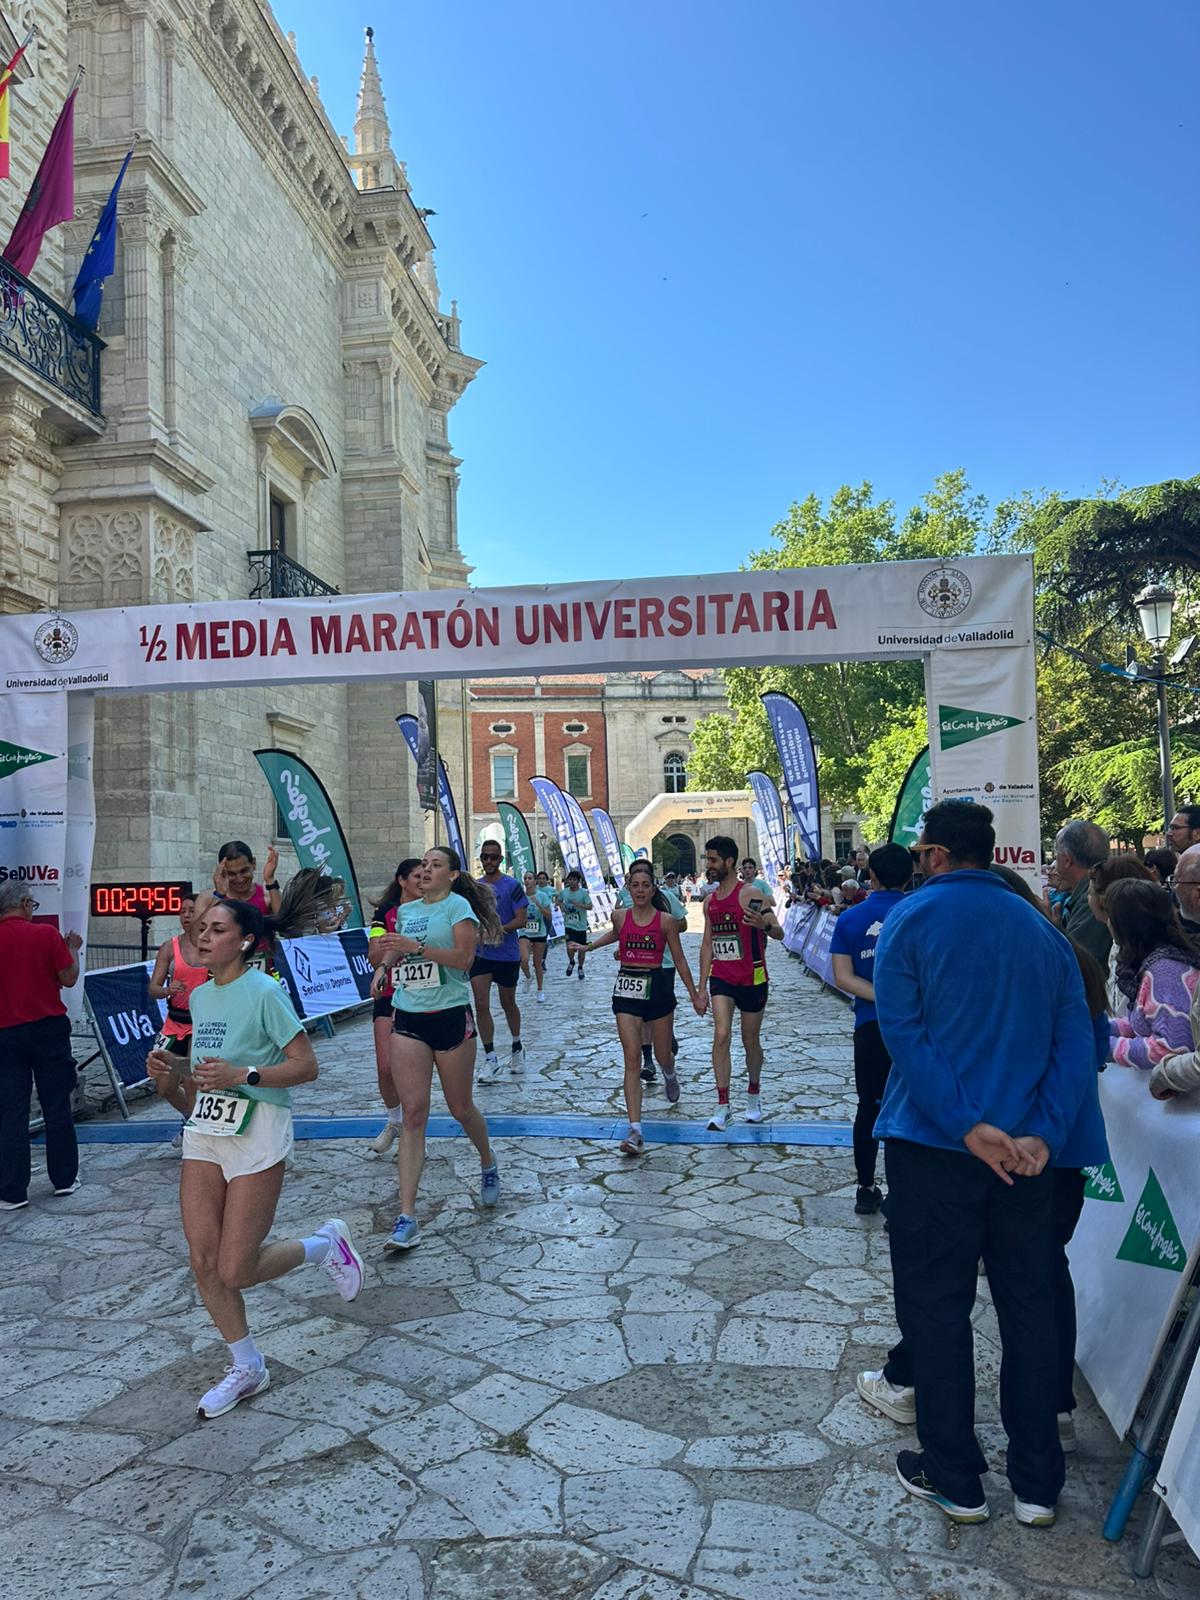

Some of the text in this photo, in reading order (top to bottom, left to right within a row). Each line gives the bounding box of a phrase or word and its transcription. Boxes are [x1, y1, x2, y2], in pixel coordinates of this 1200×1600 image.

[176, 618, 297, 661] MEDIA
[311, 599, 500, 655] MARATÓN
[515, 588, 837, 645] UNIVERSITARIA
[878, 634, 943, 645] Universidad
[958, 629, 1014, 642] Valladolid
[6, 678, 57, 688] Universidad
[68, 673, 109, 684] Valladolid
[942, 716, 1008, 731] El Corte Inglés
[994, 846, 1035, 865] UVa
[0, 864, 59, 881] SeDUVa
[97, 887, 181, 912] 00:29:56
[713, 942, 735, 954] 1114
[404, 963, 433, 981] 1217
[618, 978, 643, 992] 1055
[108, 1009, 156, 1046] UVa
[195, 1095, 238, 1124] 1351
